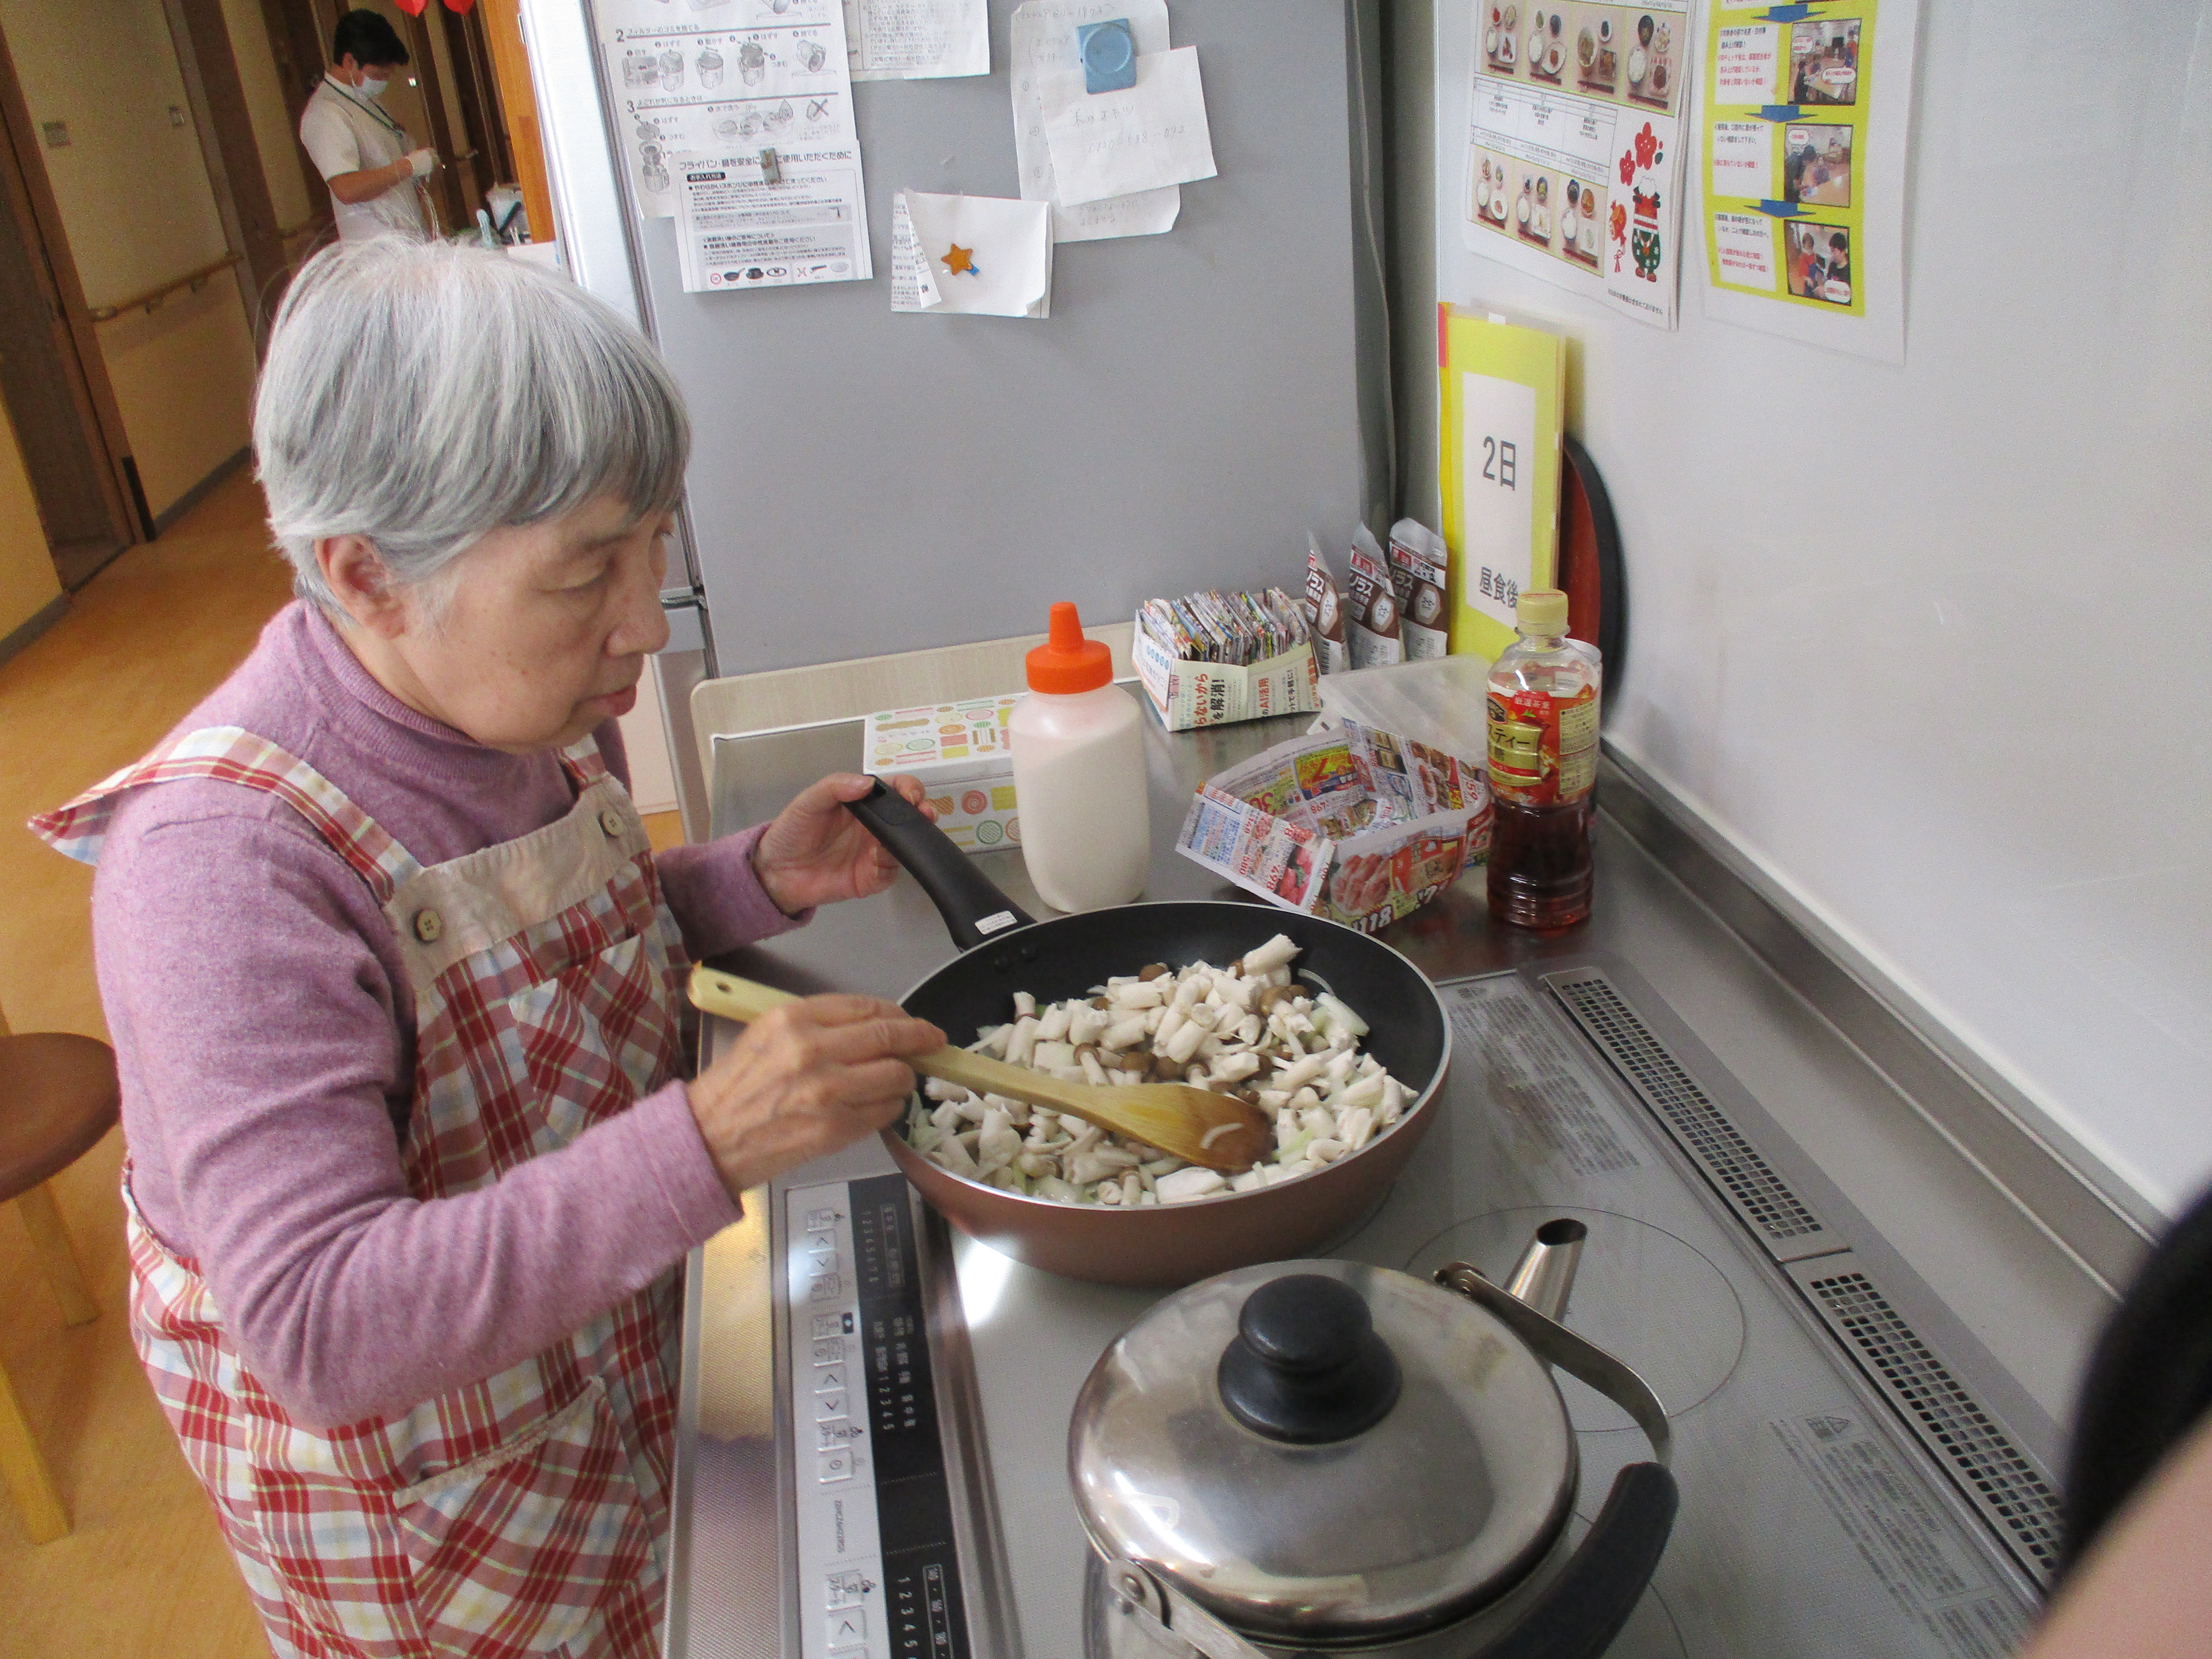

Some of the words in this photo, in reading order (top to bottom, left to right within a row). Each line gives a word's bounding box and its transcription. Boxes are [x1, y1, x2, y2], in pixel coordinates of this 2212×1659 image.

[616, 28, 625, 42] 2
[626, 100, 635, 113] 3
[1483, 436, 1517, 492] 2日
[1480, 565, 1518, 609] 昼食後
[899, 1591, 913, 1600] 2
[901, 1607, 915, 1616] 3
[902, 1623, 916, 1632] 4
[904, 1638, 918, 1648] 5
